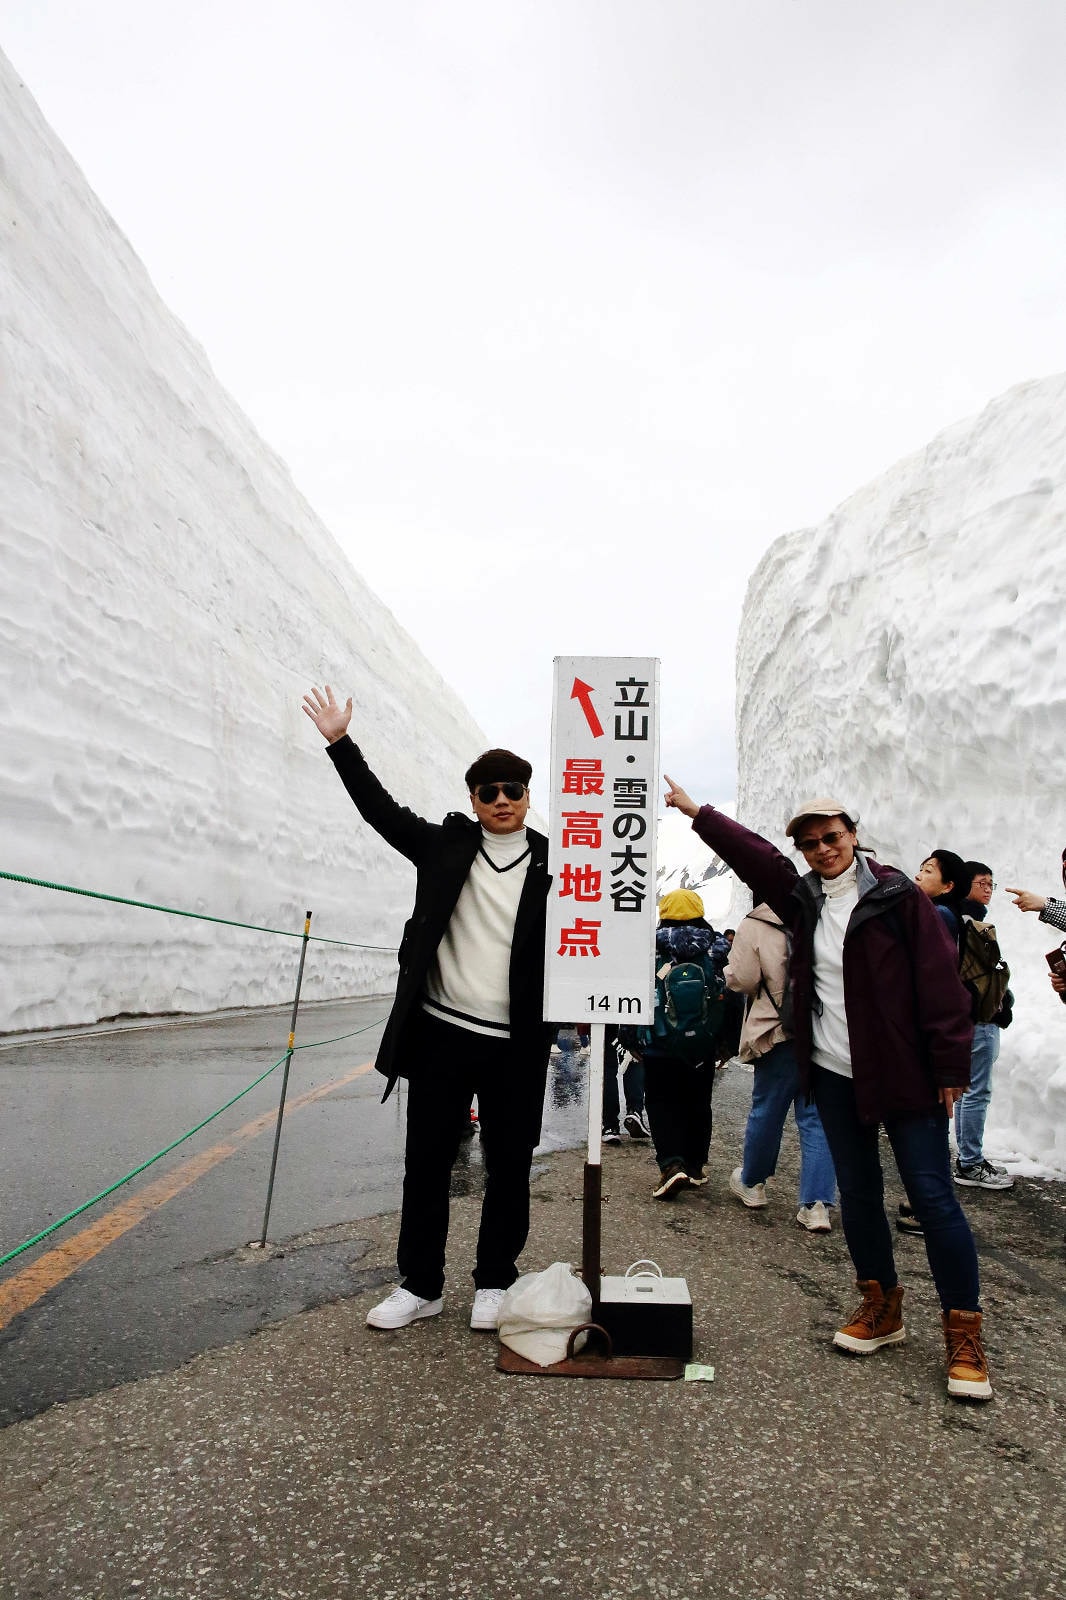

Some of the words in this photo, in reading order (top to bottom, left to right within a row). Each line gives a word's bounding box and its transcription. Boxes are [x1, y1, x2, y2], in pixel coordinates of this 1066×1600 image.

[556, 758, 606, 958] 最高地点
[609, 677, 650, 913] 立山・雪の大谷
[587, 995, 612, 1011] 14
[618, 997, 642, 1014] m
